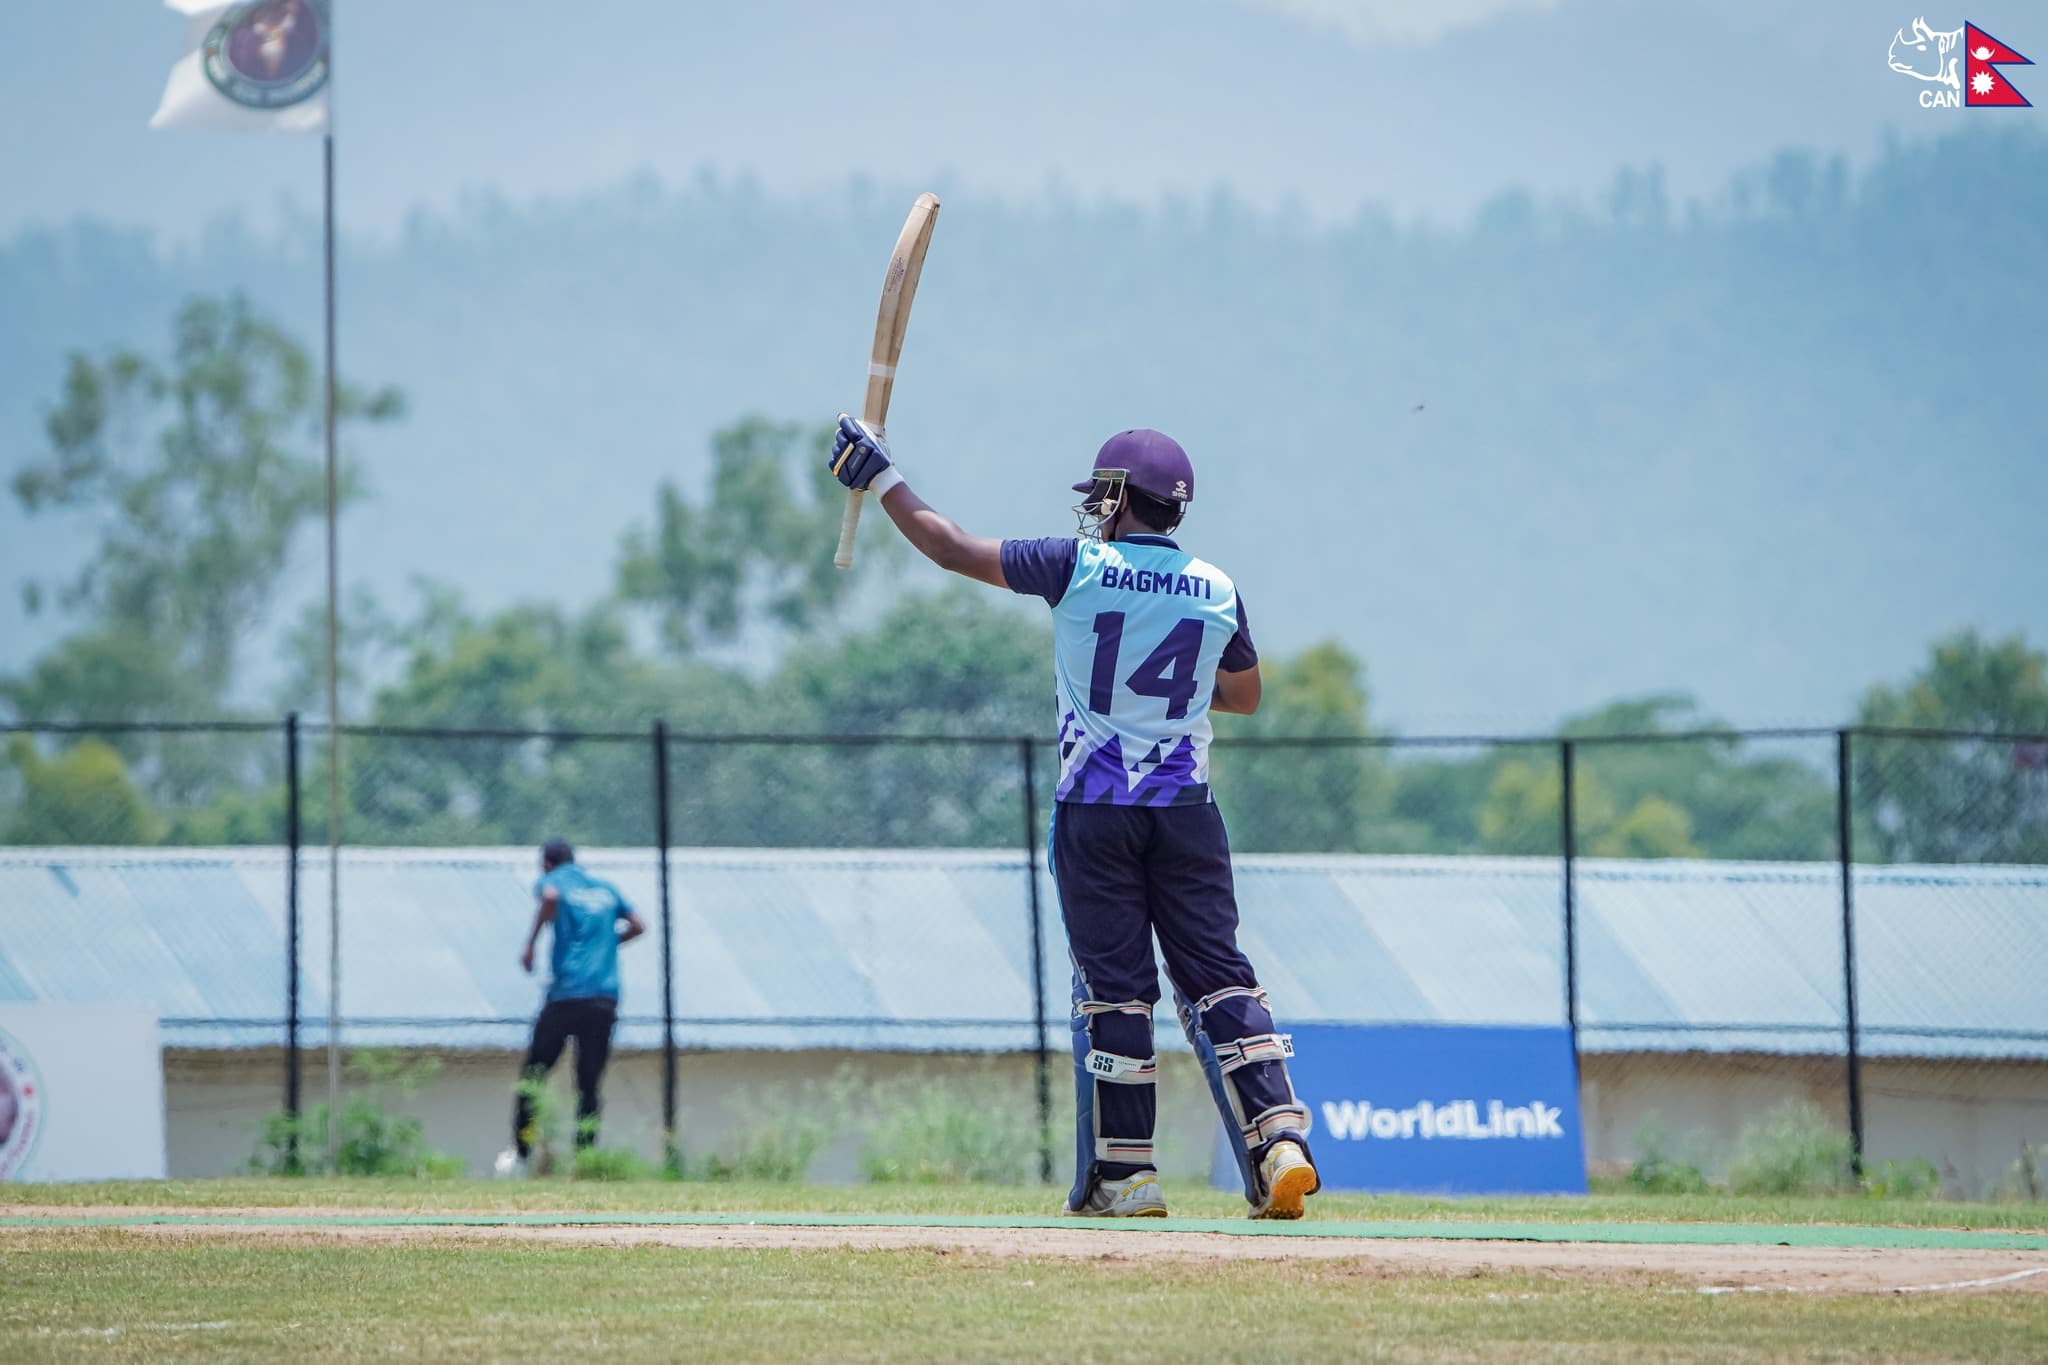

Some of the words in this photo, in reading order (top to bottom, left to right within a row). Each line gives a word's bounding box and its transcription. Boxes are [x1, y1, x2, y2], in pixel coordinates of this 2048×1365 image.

[1101, 566, 1210, 599] BAGMATI
[1089, 611, 1204, 719] 14
[1093, 1054, 1114, 1073] SS
[1322, 1099, 1564, 1140] WorldLink
